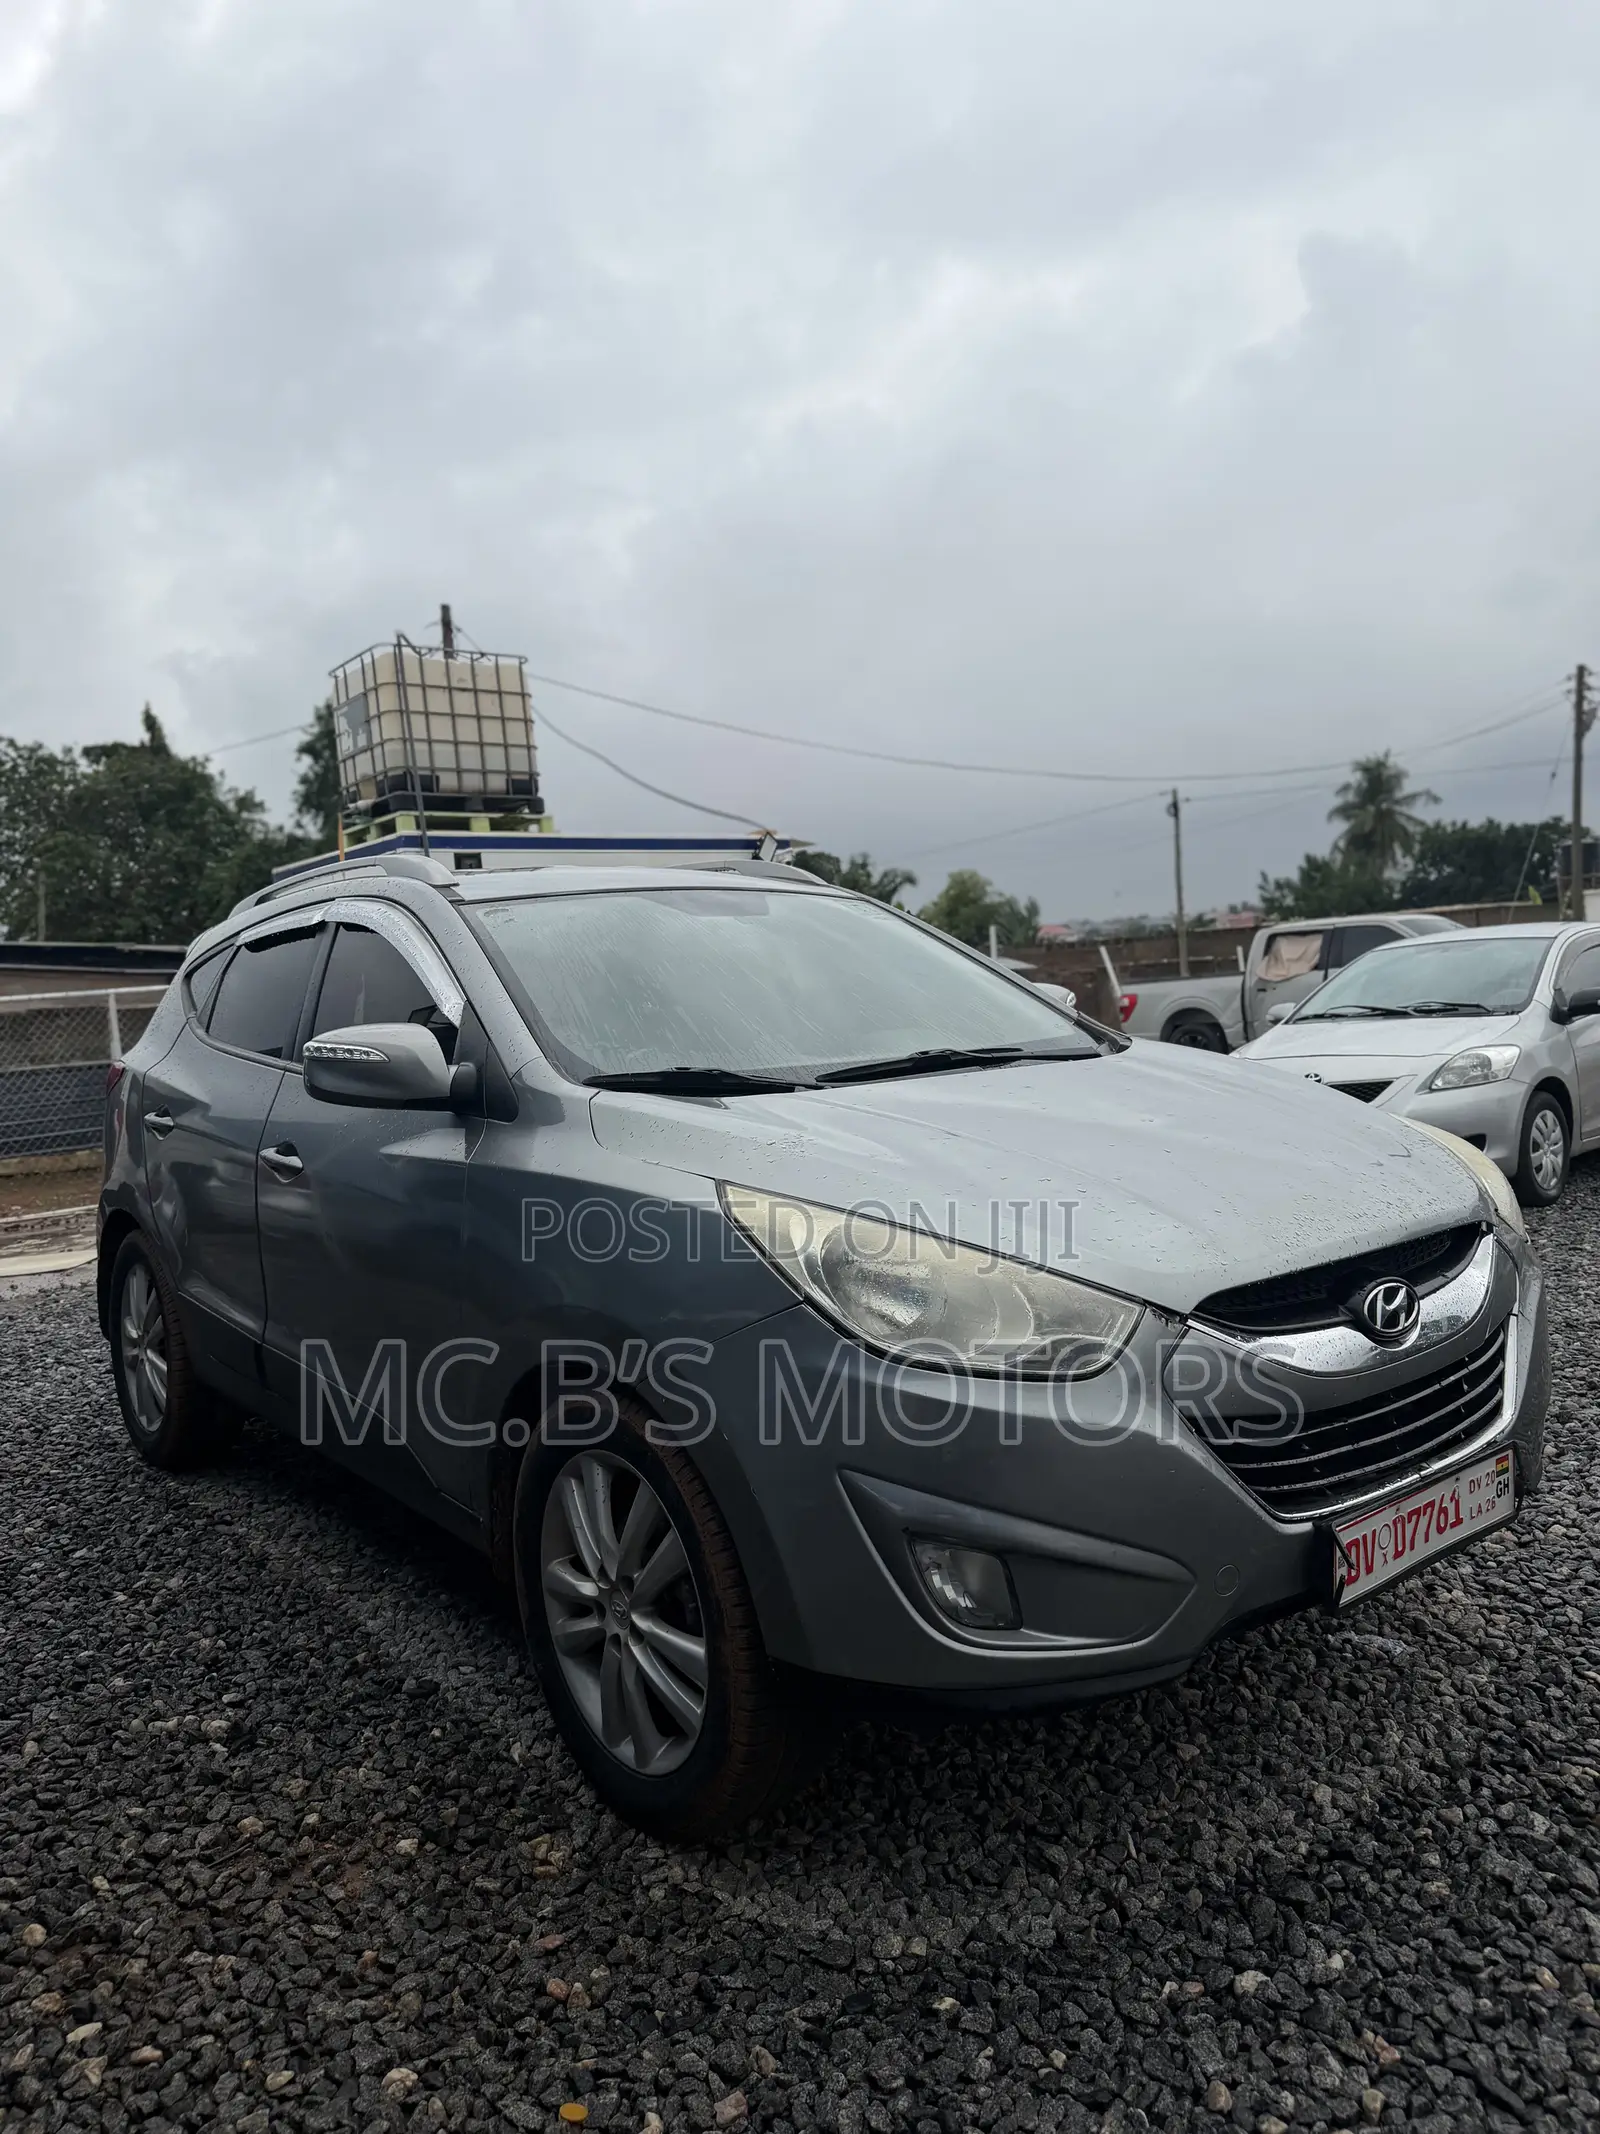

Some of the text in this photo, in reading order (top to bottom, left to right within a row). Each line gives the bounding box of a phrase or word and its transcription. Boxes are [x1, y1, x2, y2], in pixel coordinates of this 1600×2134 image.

[1469, 1475, 1482, 1494] DV
[1496, 1476, 1509, 1498] GH
[1470, 1502, 1483, 1520] LA
[1391, 1484, 1464, 1560] D7761
